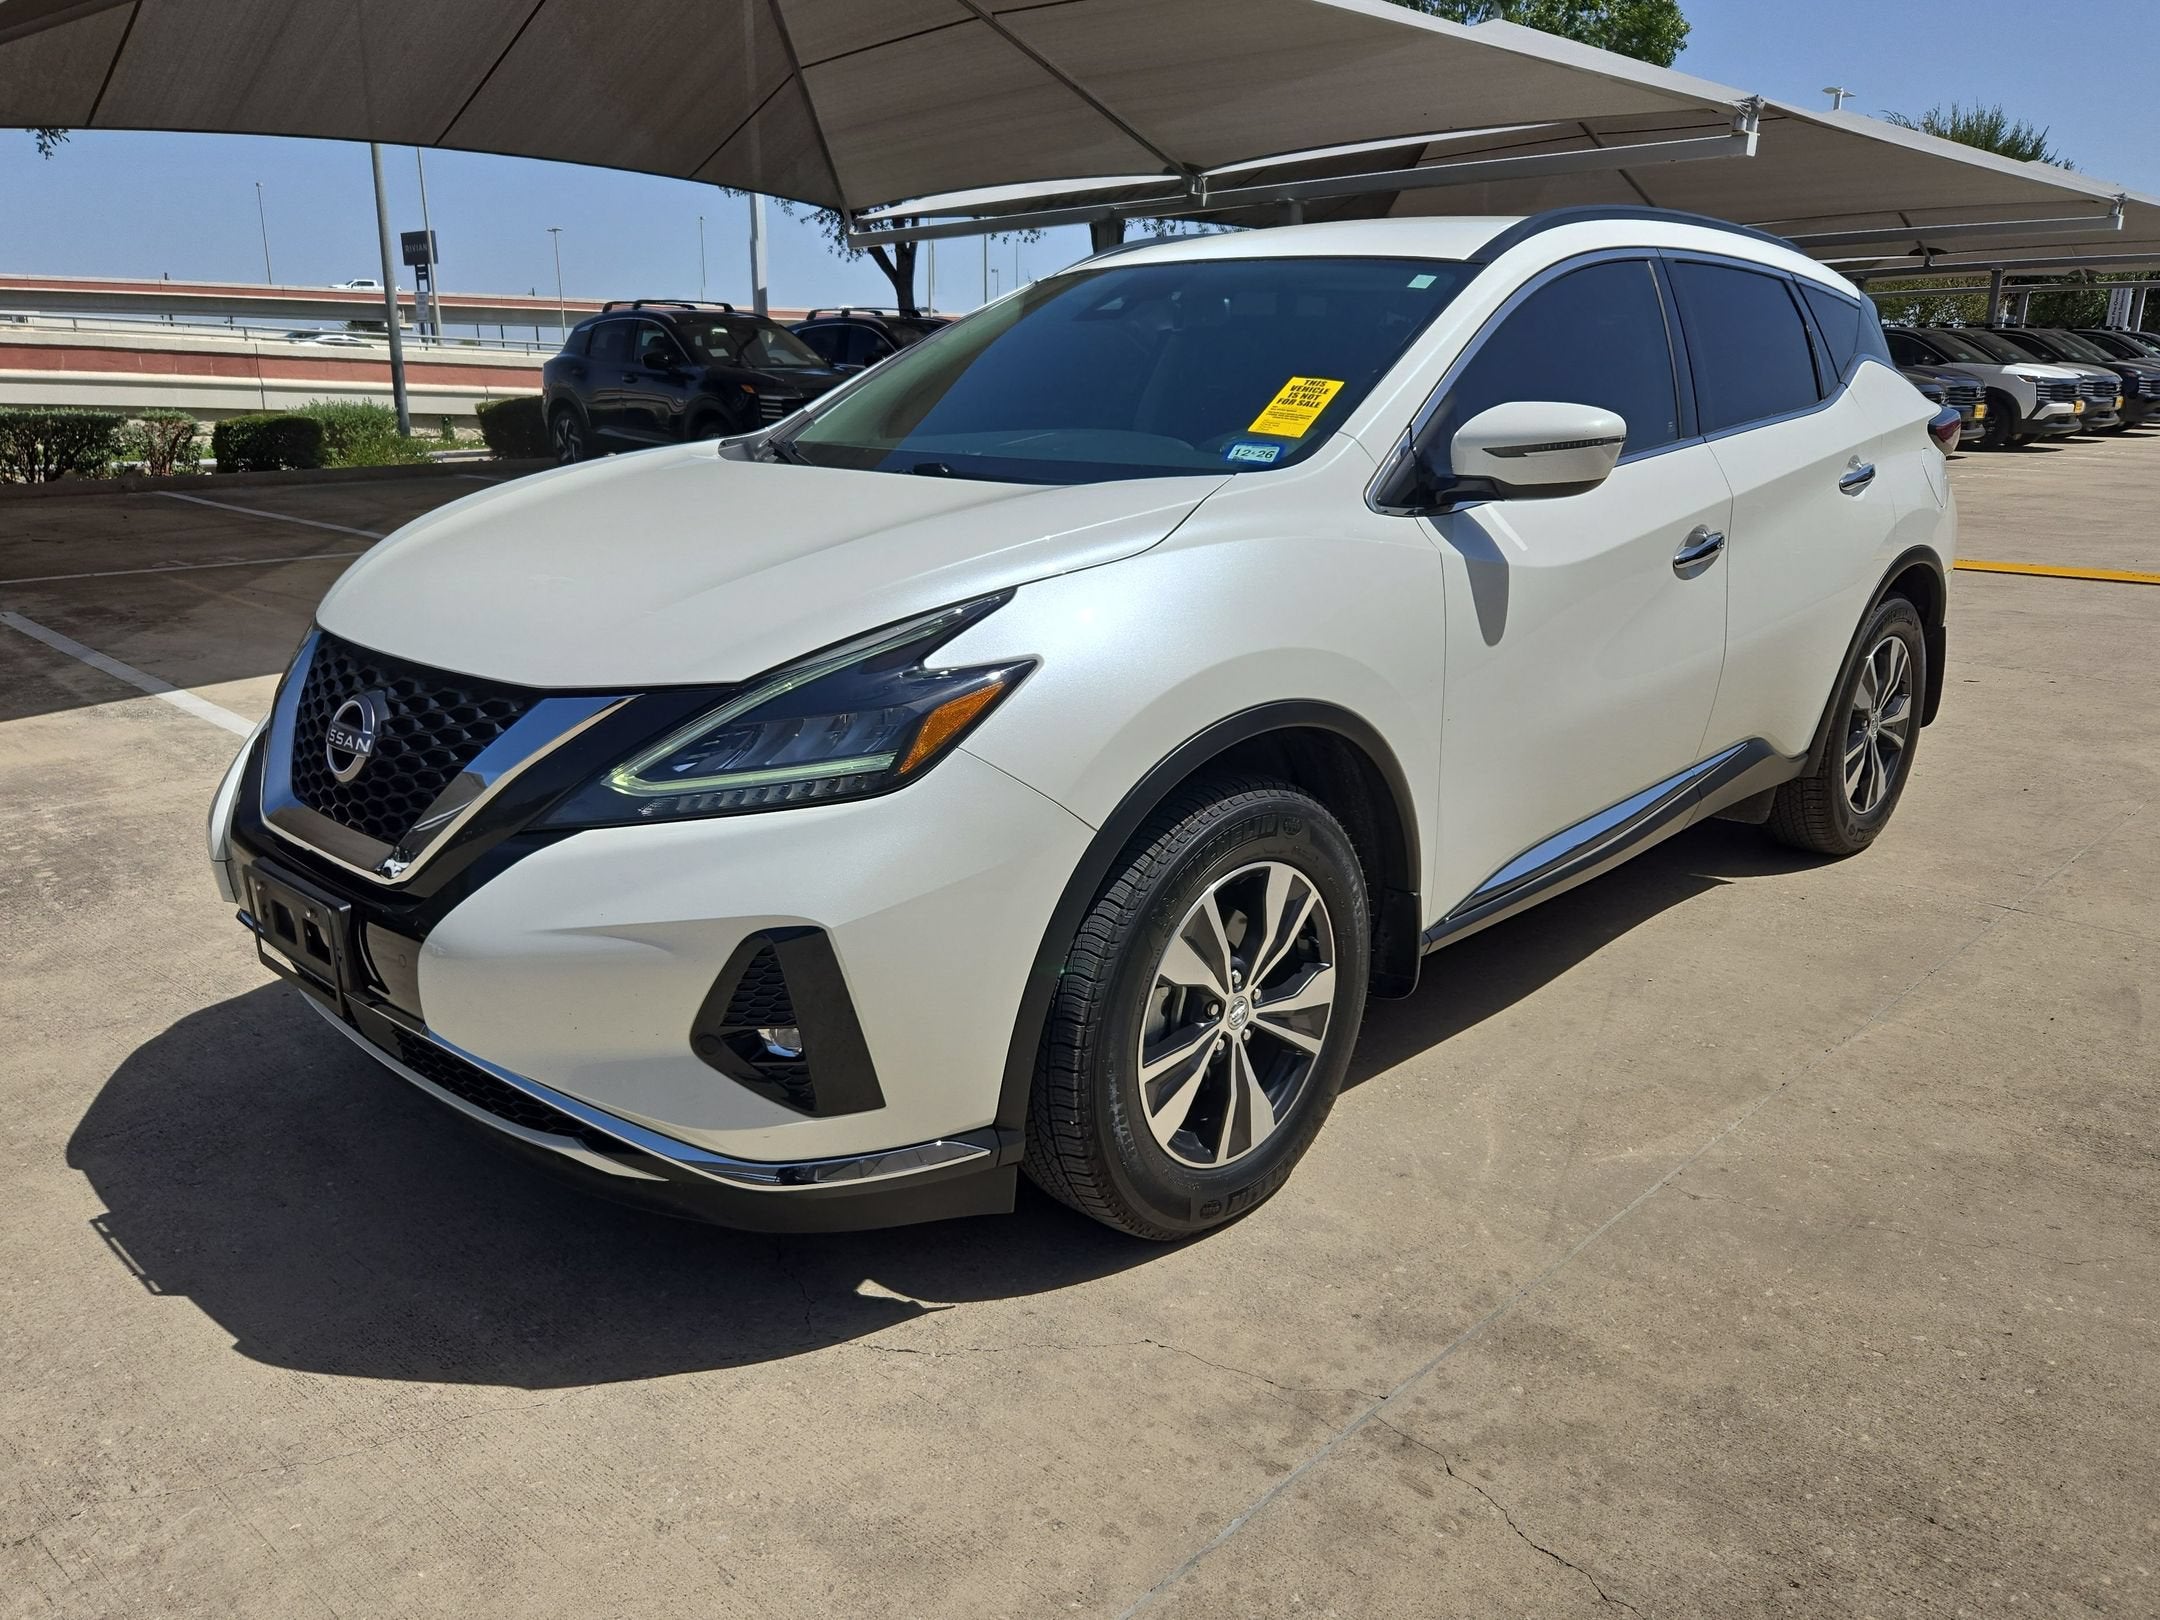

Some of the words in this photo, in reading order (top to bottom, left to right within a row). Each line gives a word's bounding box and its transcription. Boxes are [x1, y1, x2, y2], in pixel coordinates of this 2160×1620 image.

[404, 243, 428, 253] RIVIAN
[1304, 379, 1327, 387] THIS
[1290, 385, 1330, 394] VEHICLE
[1297, 400, 1322, 408] SALE
[329, 729, 371, 752] SSAN
